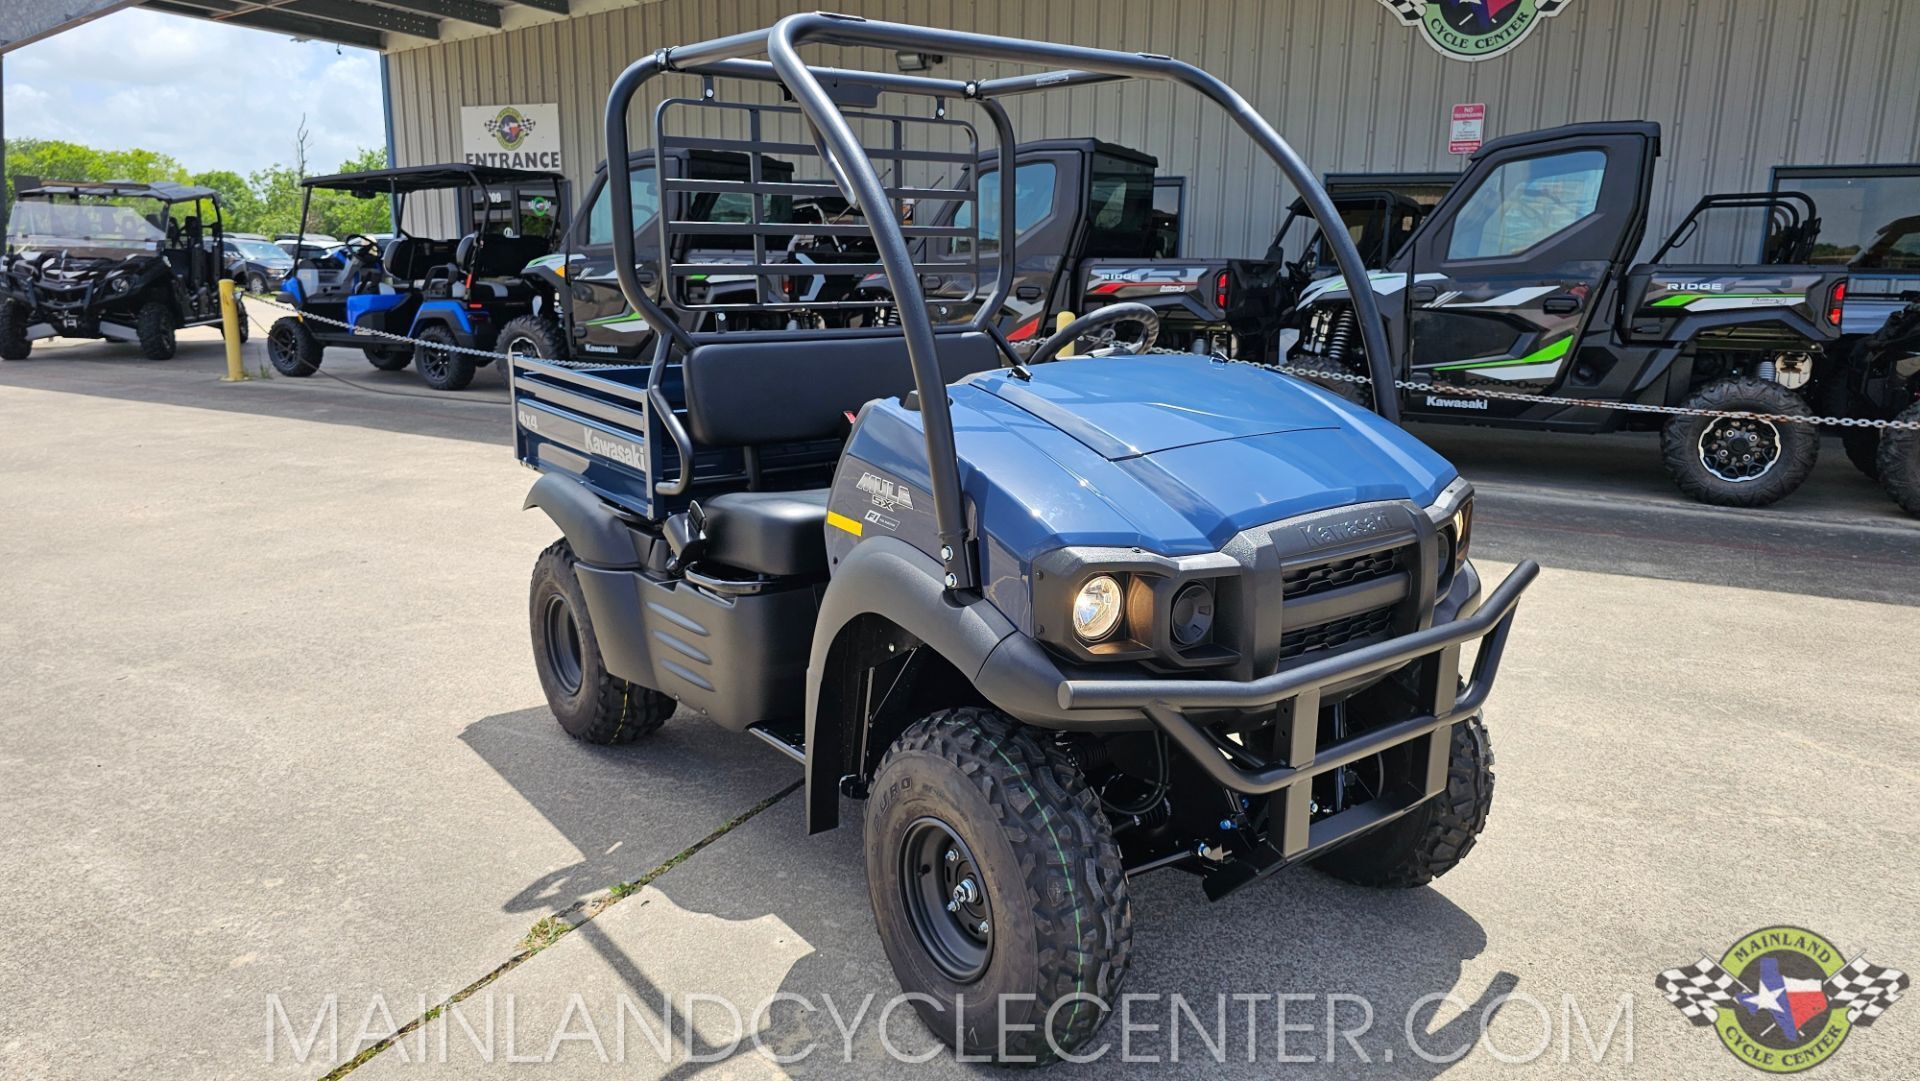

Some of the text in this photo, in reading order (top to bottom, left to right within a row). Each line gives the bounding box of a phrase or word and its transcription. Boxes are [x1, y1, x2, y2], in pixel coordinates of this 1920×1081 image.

[1431, 11, 1530, 49] CYCLE CENTER
[465, 152, 560, 168] ENTRANCE
[1101, 272, 1140, 280] RIDGE
[1667, 282, 1722, 290] RIDGE
[585, 343, 618, 353] Kawasaki
[1426, 396, 1488, 409] Kawasaki
[583, 427, 646, 470] Kawasaki
[856, 472, 914, 510] MULE
[872, 494, 894, 512] SX
[1300, 510, 1392, 547] Kawasaki
